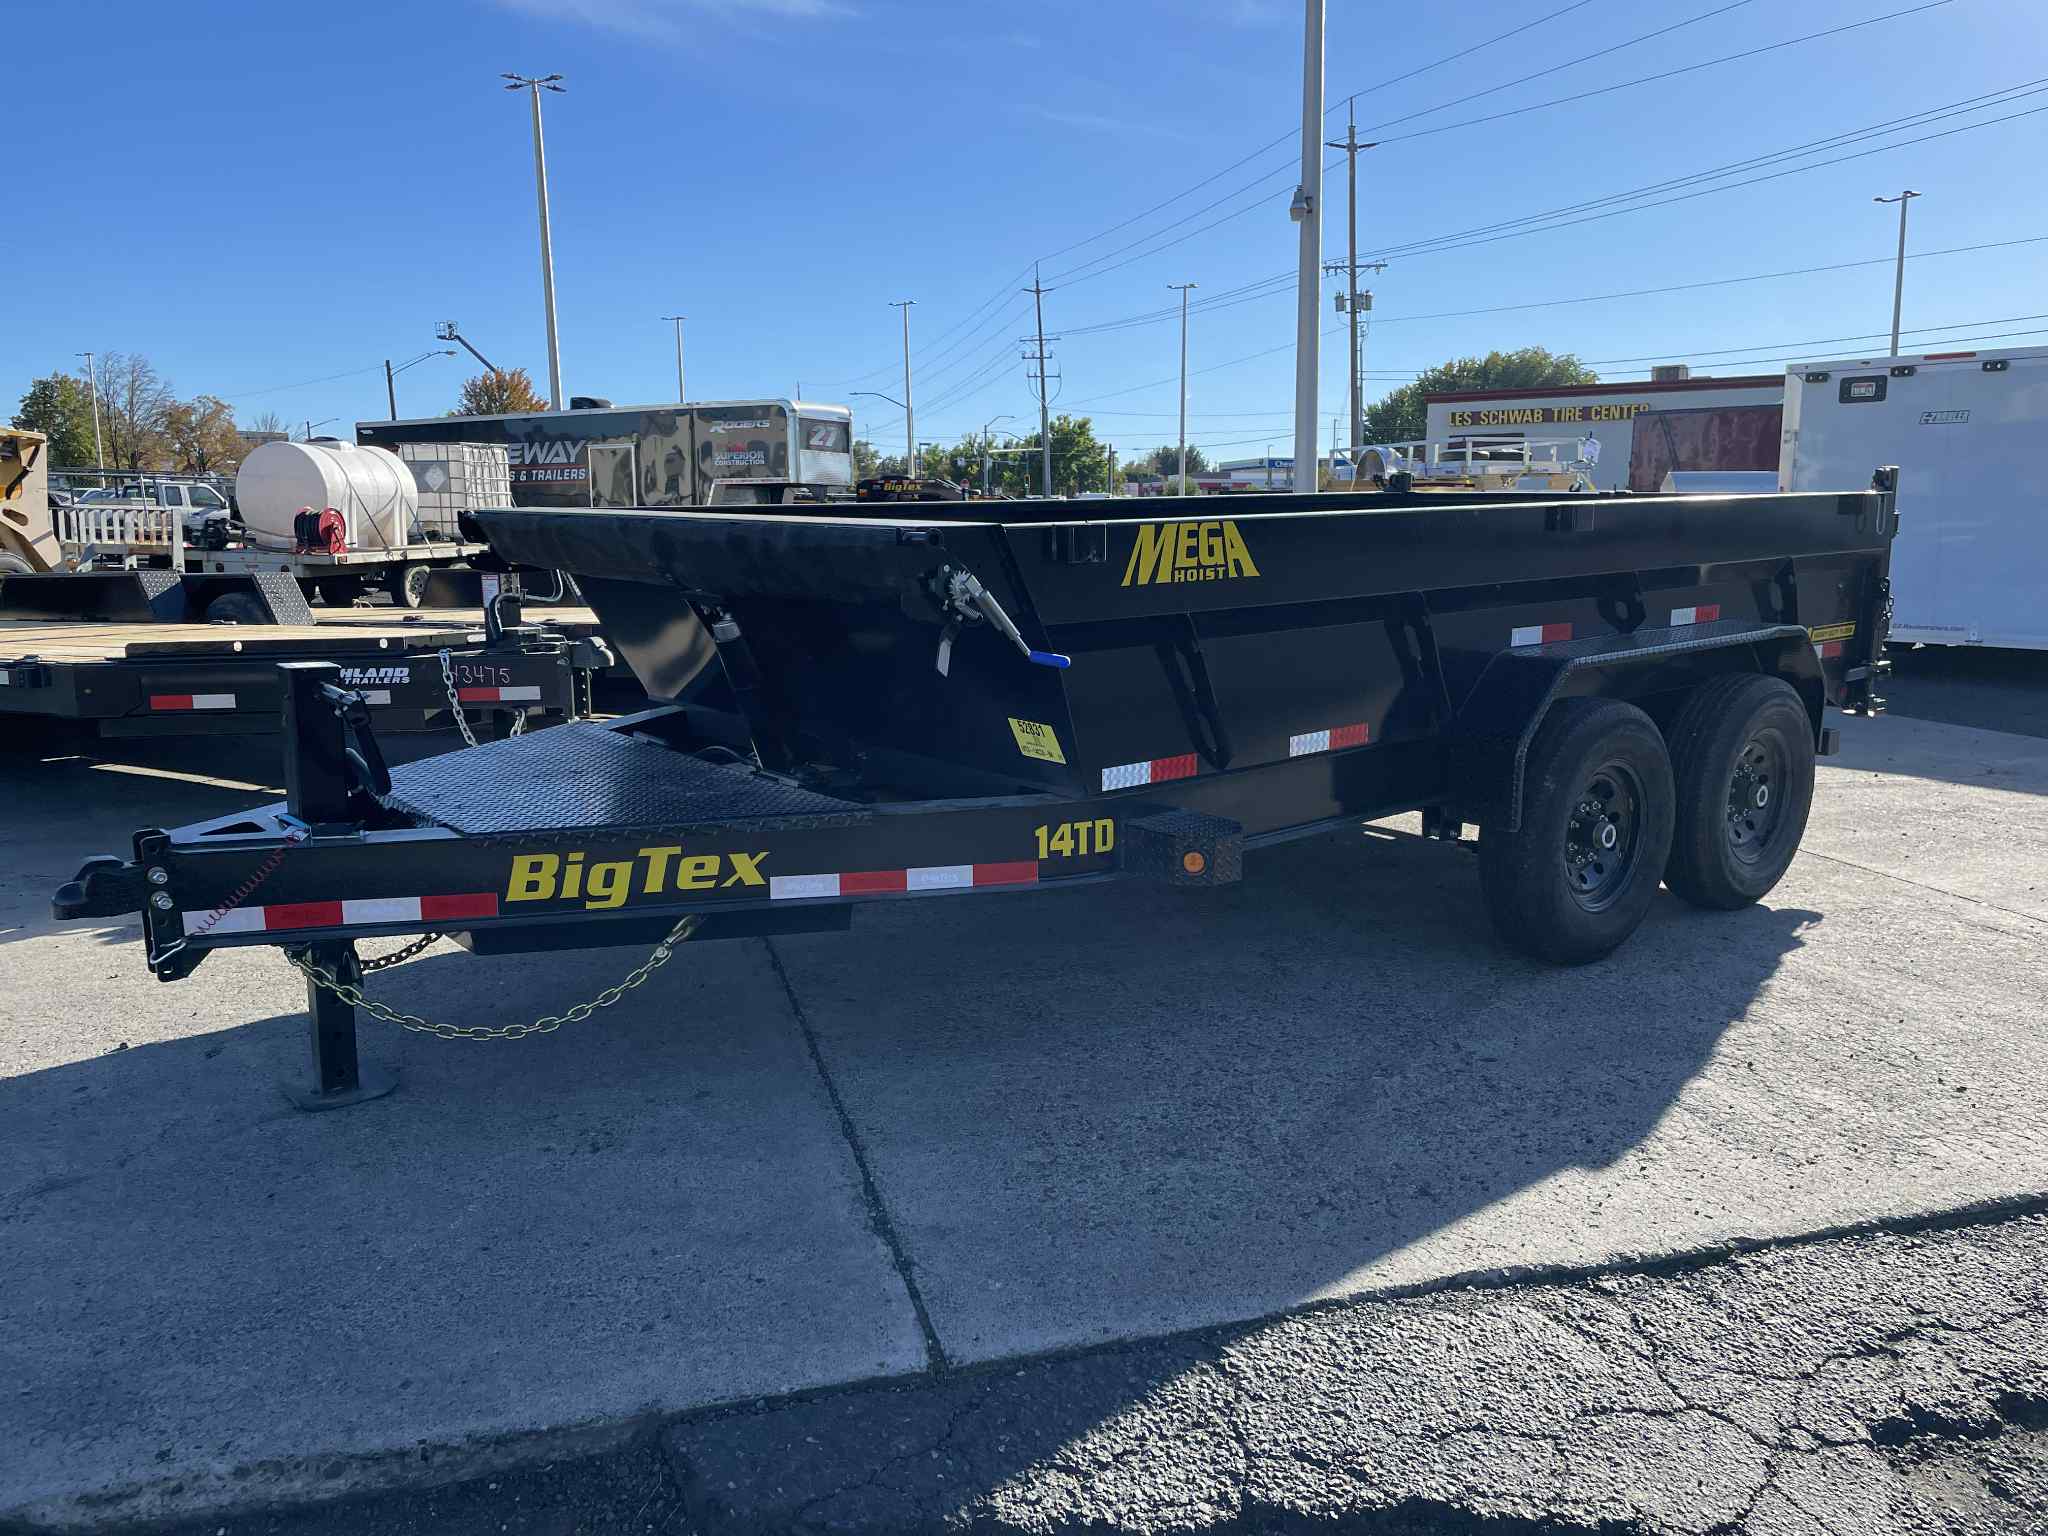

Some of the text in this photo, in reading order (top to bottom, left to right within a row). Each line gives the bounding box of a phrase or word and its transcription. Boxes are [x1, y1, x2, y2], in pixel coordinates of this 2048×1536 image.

[1449, 412, 1472, 426] LES
[1480, 408, 1543, 425] SCHWAB
[1552, 407, 1583, 422] TIRE
[532, 468, 586, 481] TRAILERS
[1120, 520, 1261, 587] MEGA
[1174, 567, 1226, 583] HOIST
[344, 676, 410, 685] TRAILERS
[1035, 818, 1114, 859] 14TD
[505, 846, 770, 910] BigTex
